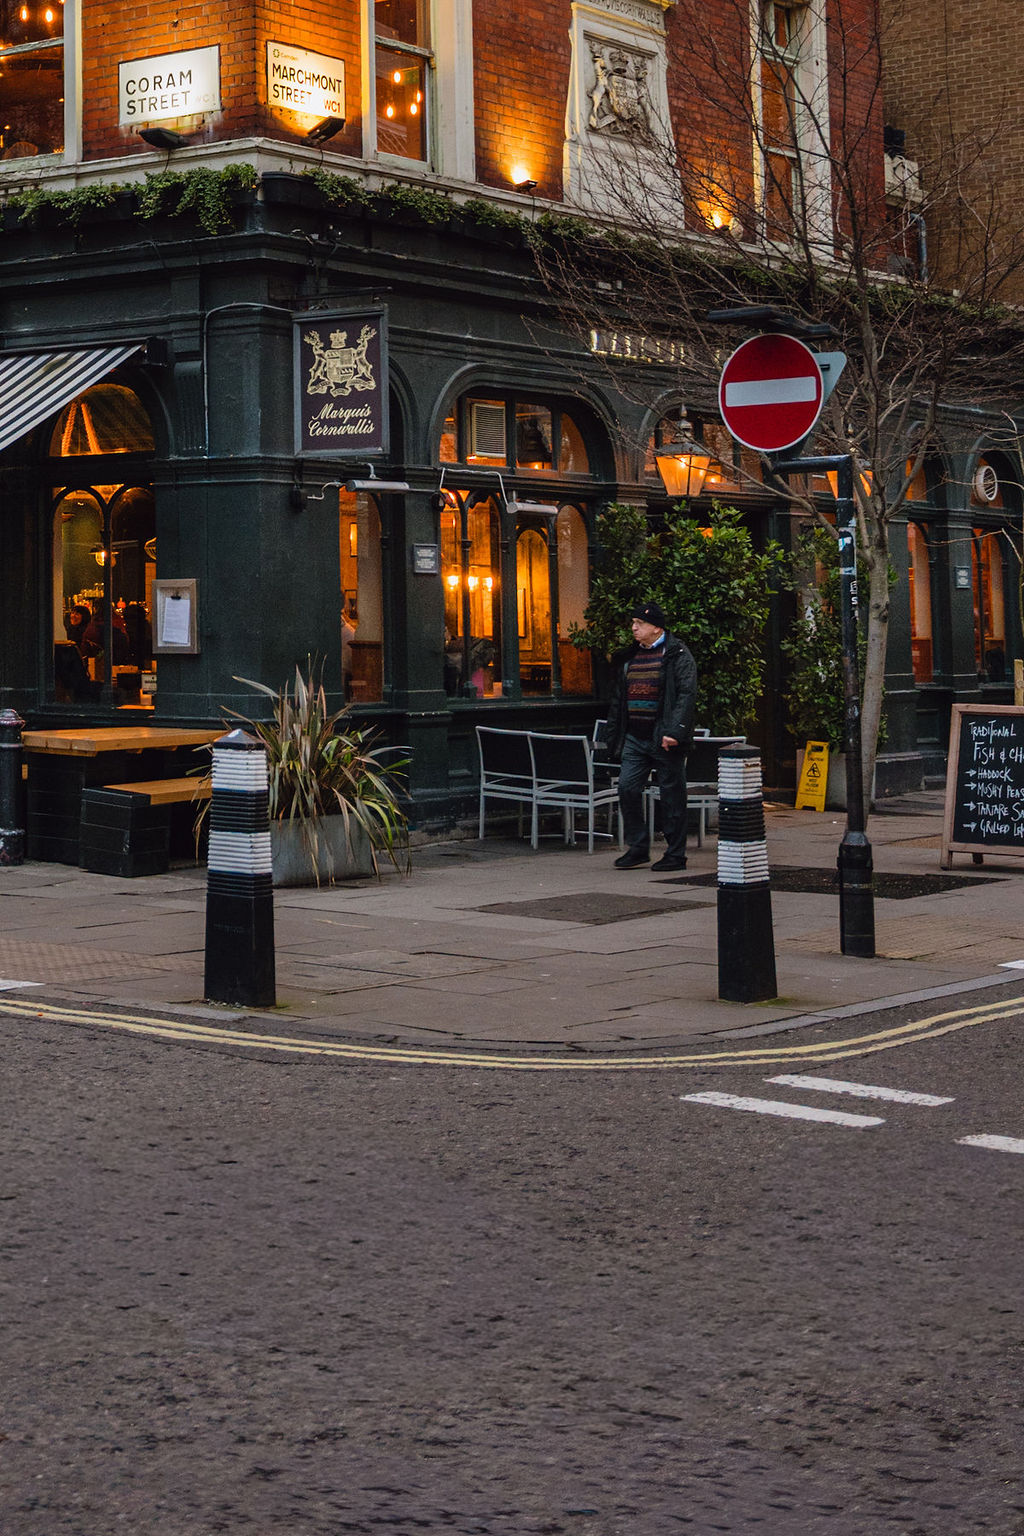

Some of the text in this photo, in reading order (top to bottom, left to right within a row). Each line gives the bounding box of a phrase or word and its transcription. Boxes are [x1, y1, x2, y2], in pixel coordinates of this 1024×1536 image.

[126, 70, 192, 95] CORAM
[273, 63, 342, 94] MARCHMONT
[126, 91, 191, 115] STREET
[273, 84, 341, 113] STREET WC1
[312, 403, 372, 424] Marquis
[309, 419, 375, 437] Cornwallis
[974, 742, 995, 765] FISH
[999, 748, 1006, 763] &
[978, 767, 1014, 782] HADDOCK
[977, 783, 1002, 798] MUSHY
[976, 802, 1009, 821] TARTARE
[980, 819, 1010, 838] GRILLED
